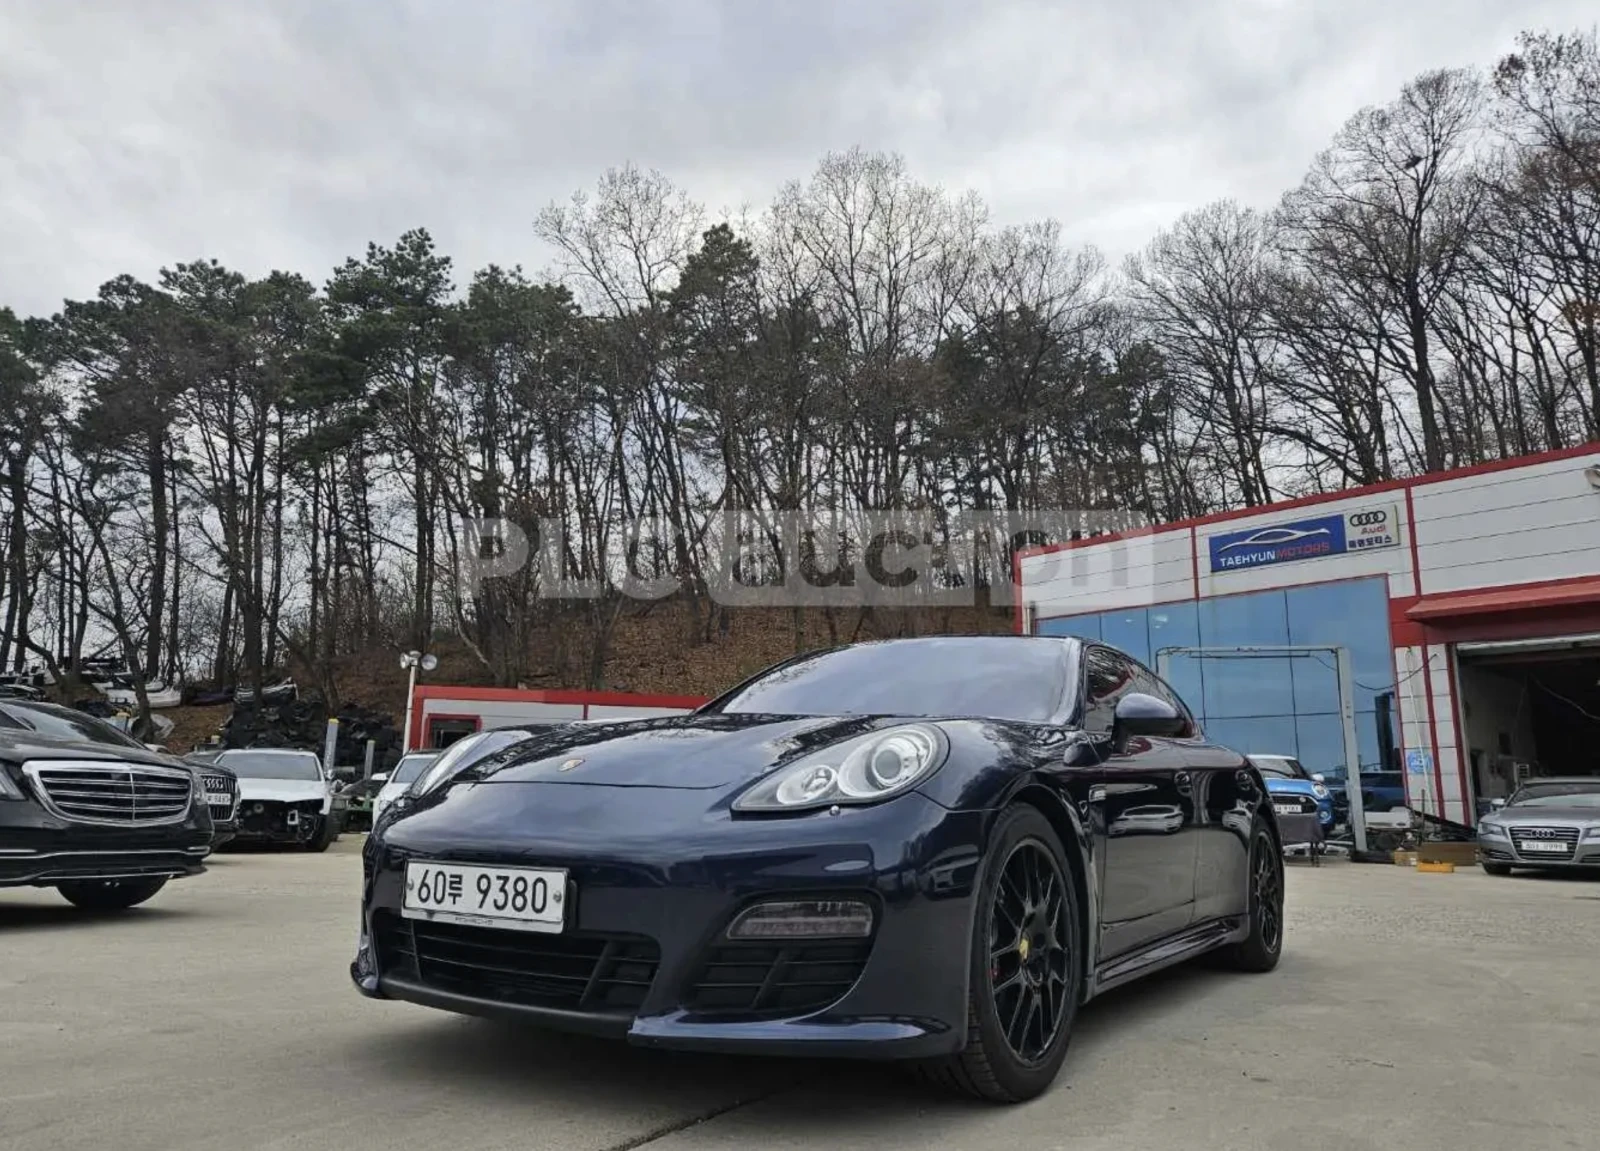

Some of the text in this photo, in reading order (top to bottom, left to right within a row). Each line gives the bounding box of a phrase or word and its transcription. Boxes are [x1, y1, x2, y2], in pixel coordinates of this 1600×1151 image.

[1361, 524, 1387, 535] Audi
[417, 869, 548, 914] 60루 9380
